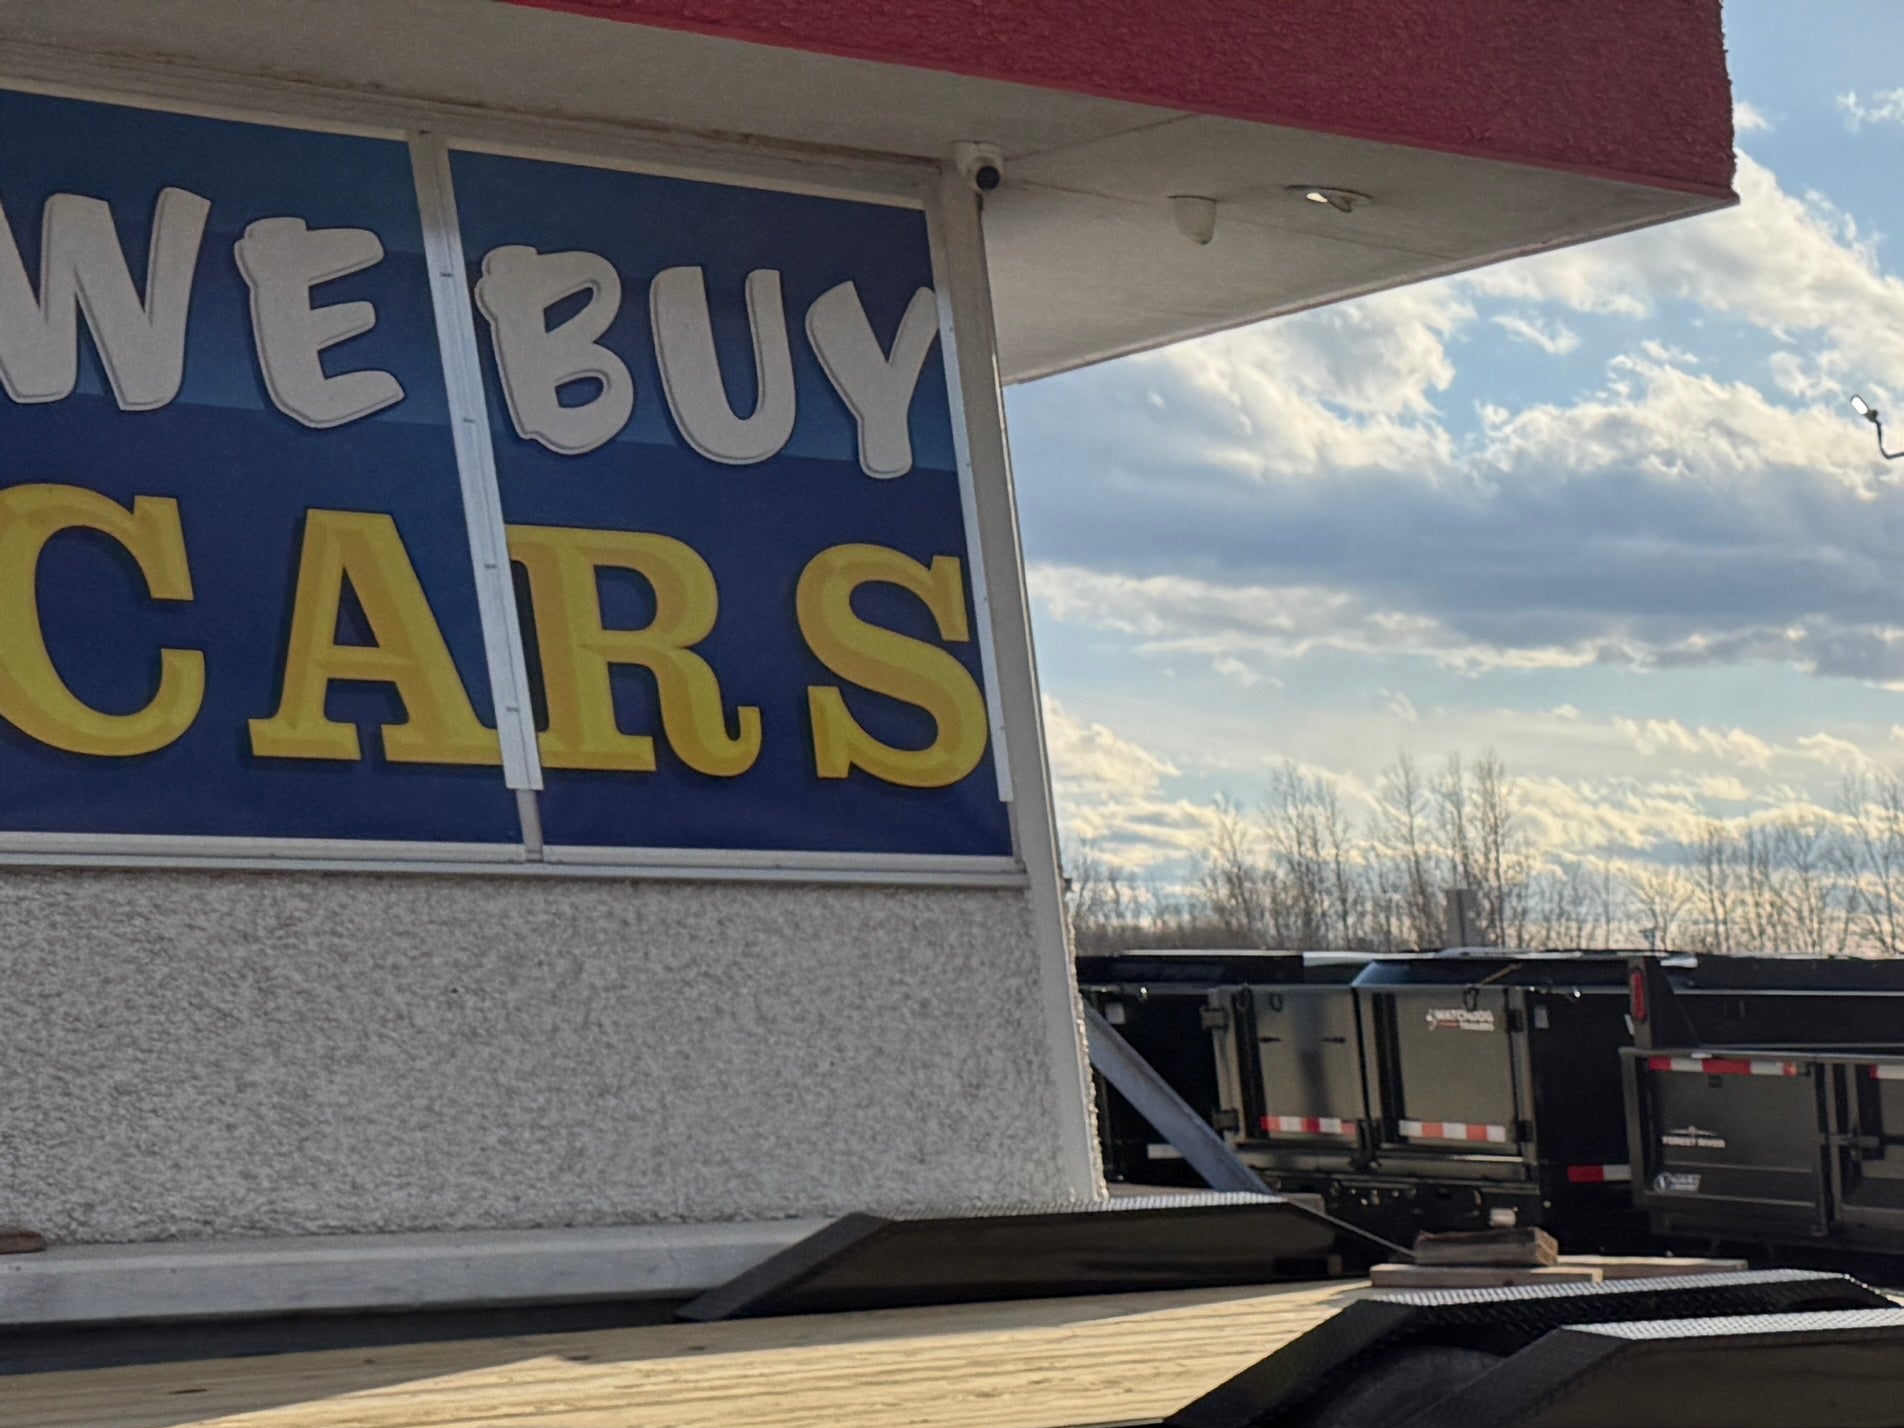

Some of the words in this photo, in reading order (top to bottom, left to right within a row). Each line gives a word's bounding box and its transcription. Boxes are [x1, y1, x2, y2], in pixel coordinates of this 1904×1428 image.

[0, 187, 405, 428] WE
[475, 244, 941, 479] BUY
[0, 481, 988, 787] CARS
